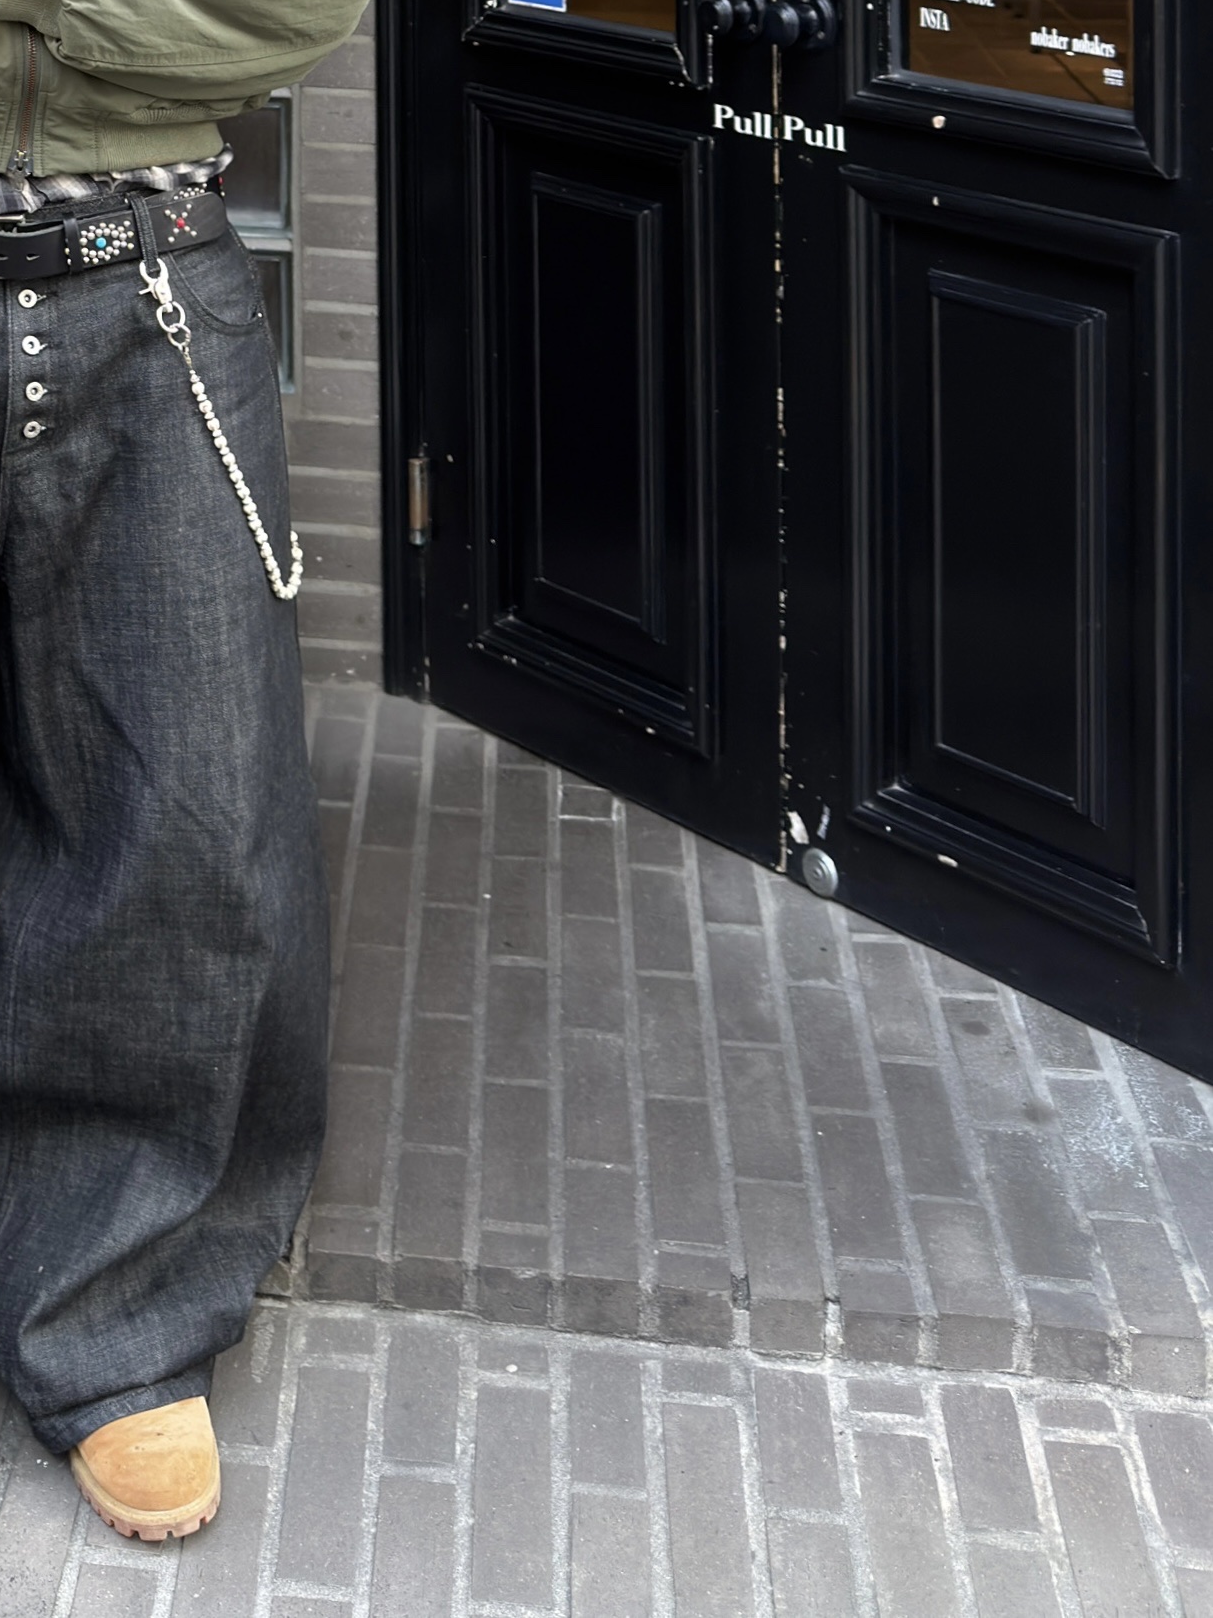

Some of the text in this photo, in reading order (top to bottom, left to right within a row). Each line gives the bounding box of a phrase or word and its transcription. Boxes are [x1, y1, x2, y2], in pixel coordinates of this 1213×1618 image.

[919, 7, 950, 31] INSTA
[712, 103, 847, 152] Pull Pull
